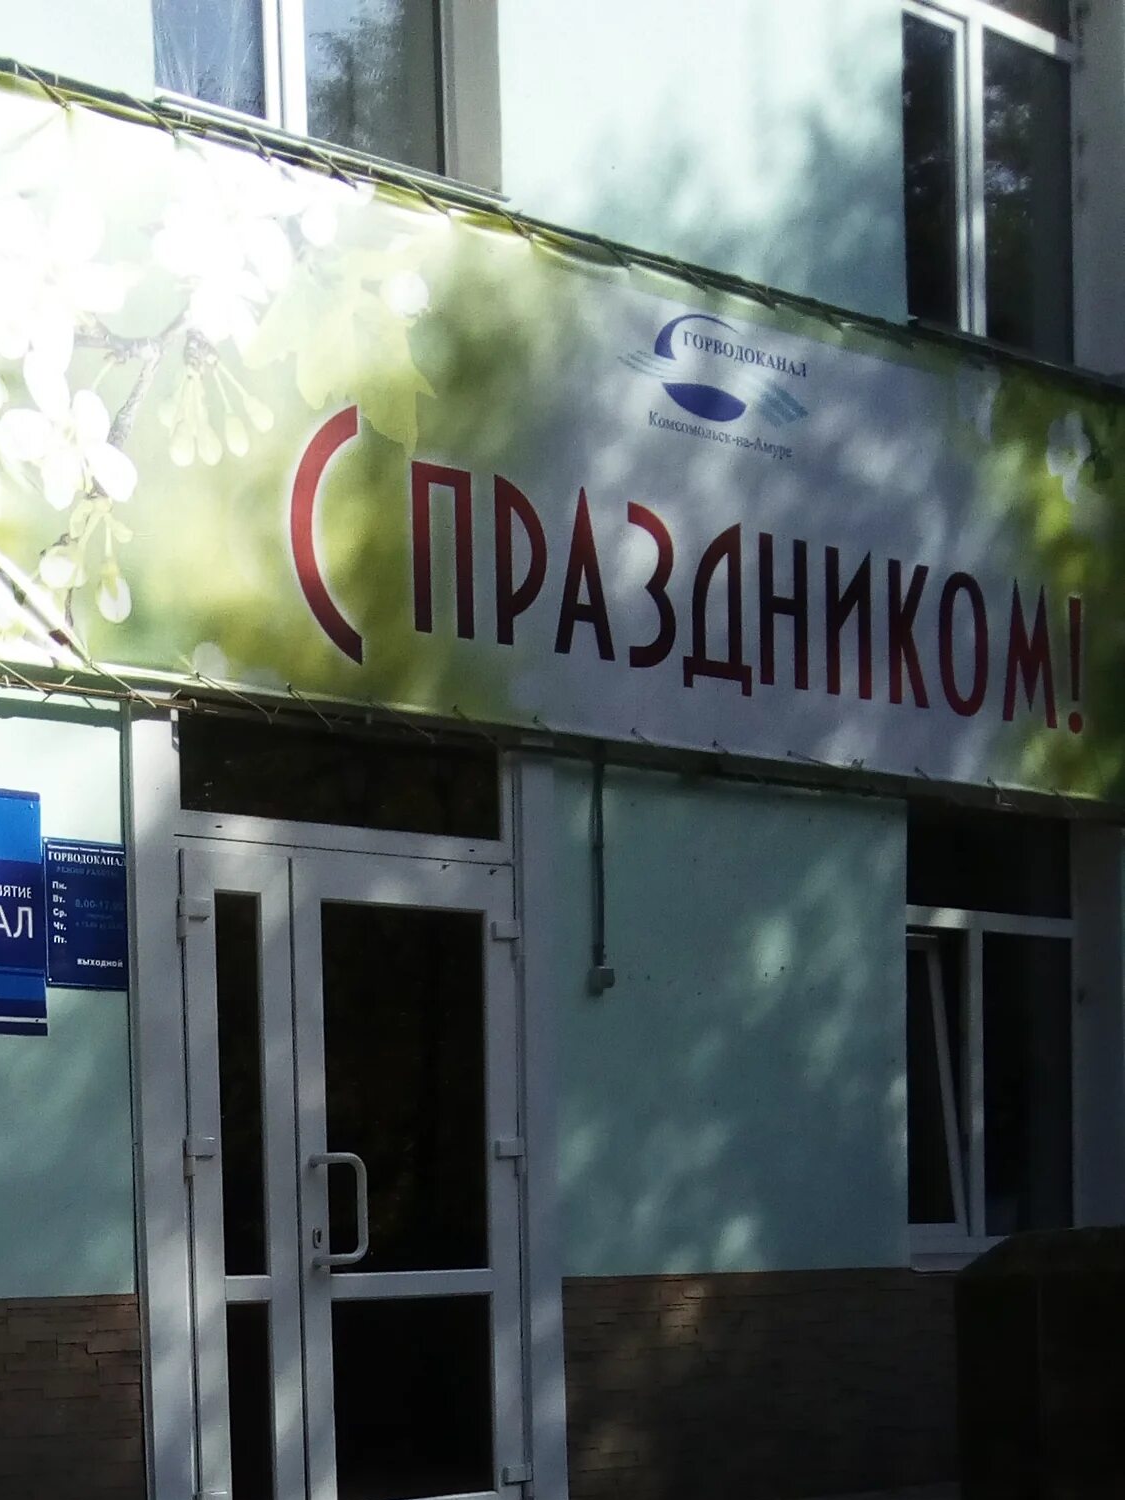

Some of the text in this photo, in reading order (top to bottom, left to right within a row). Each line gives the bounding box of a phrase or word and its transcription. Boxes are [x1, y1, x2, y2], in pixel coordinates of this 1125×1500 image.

[682, 330, 808, 378] ГОРВОДОКАНАЛ
[648, 410, 794, 460] Комсомольск-на-Амуре
[290, 404, 1086, 735] С ПРАЗДНИКОМ!
